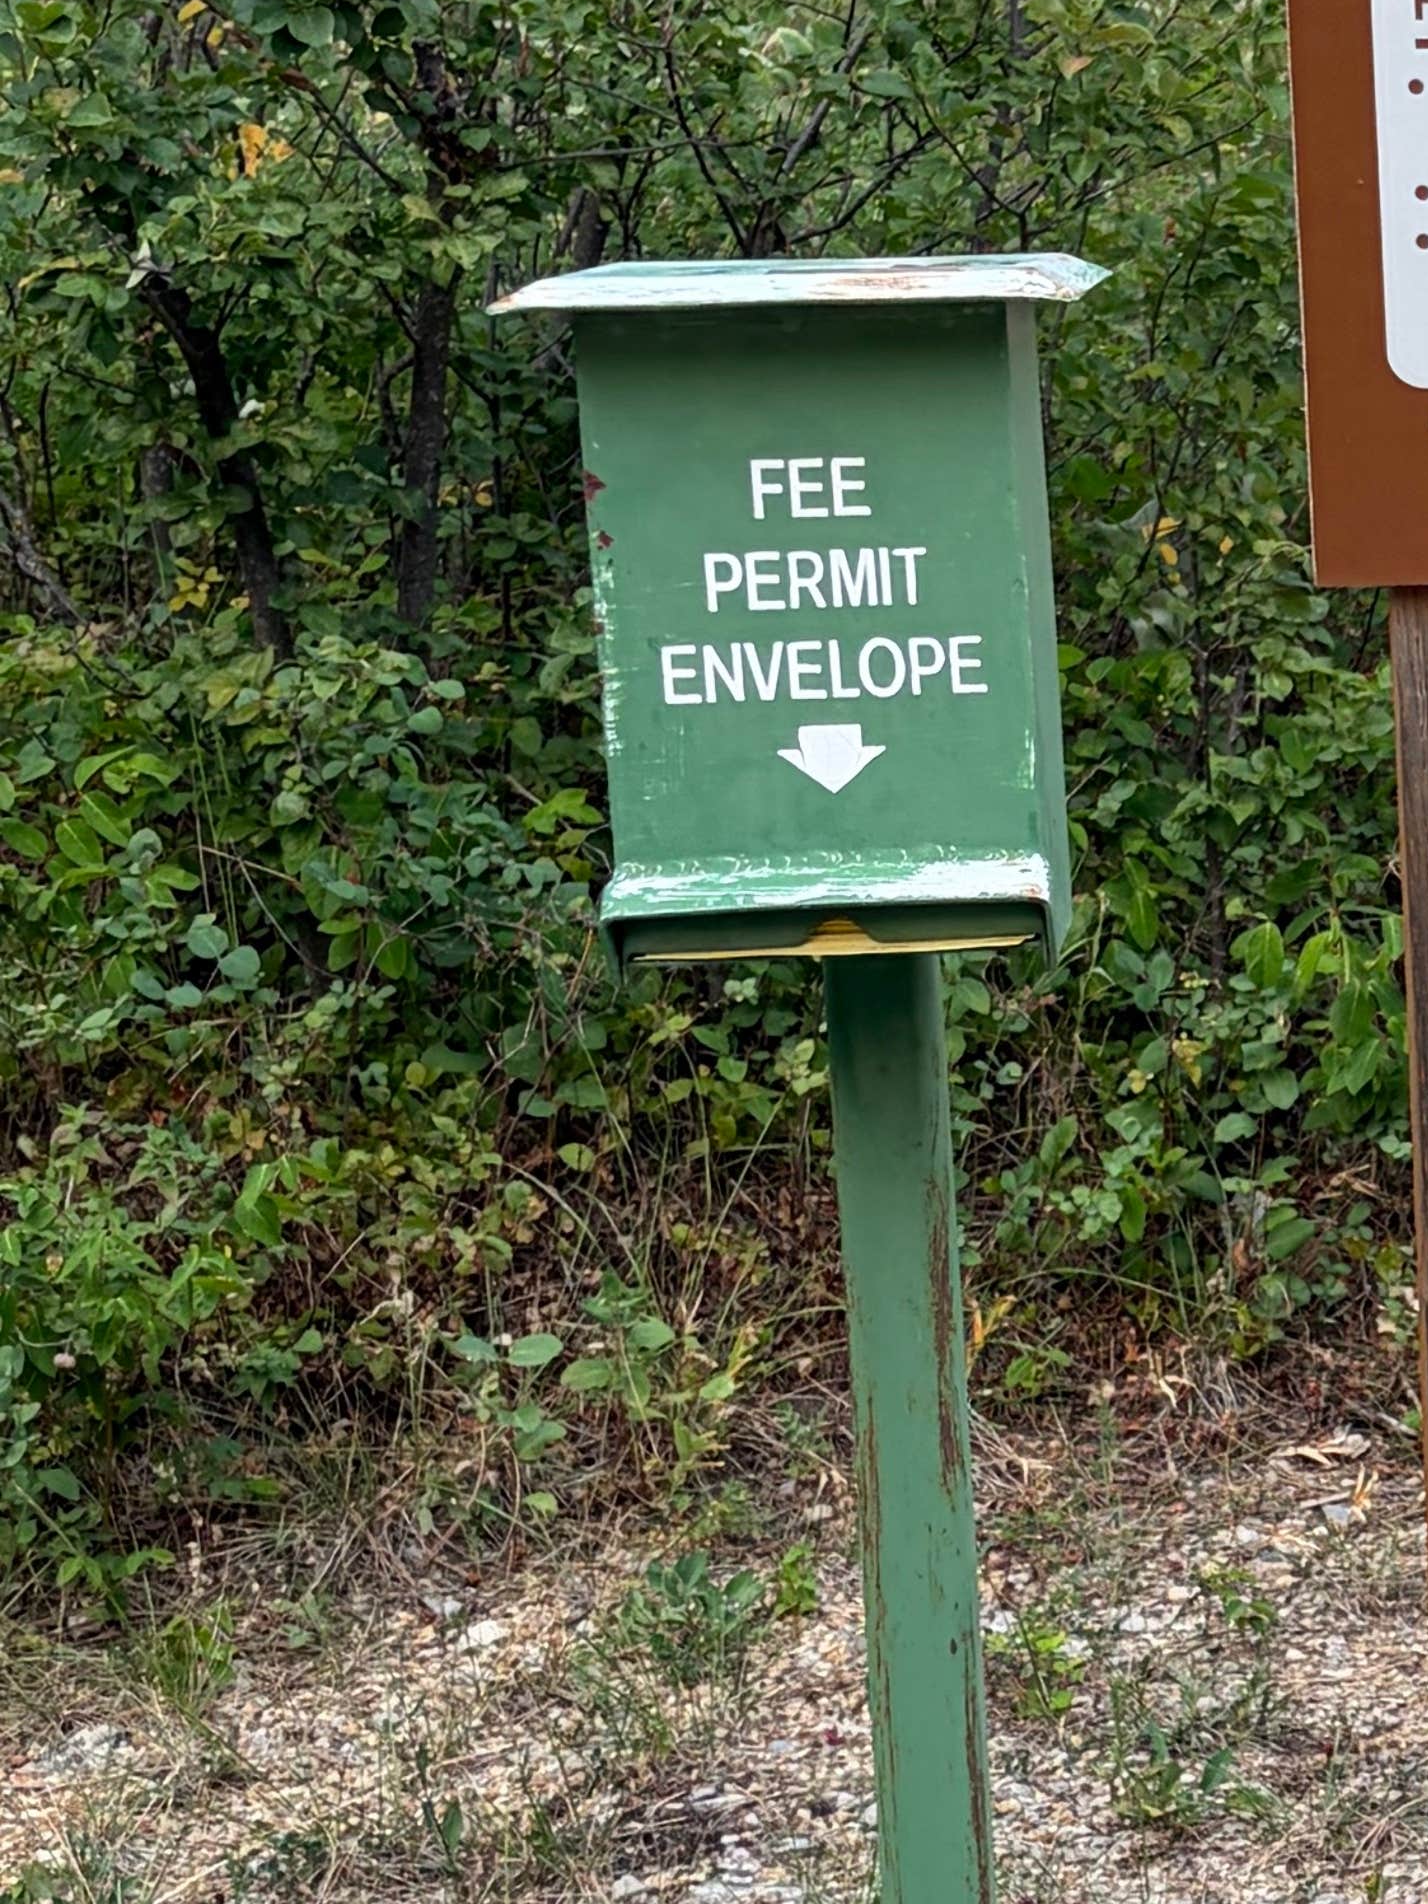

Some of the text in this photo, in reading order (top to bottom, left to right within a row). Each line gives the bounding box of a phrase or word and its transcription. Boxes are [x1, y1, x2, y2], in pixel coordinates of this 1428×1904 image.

[750, 456, 872, 520] FEE
[703, 546, 927, 613] PERMIT
[660, 634, 989, 705] ENVELOPE
